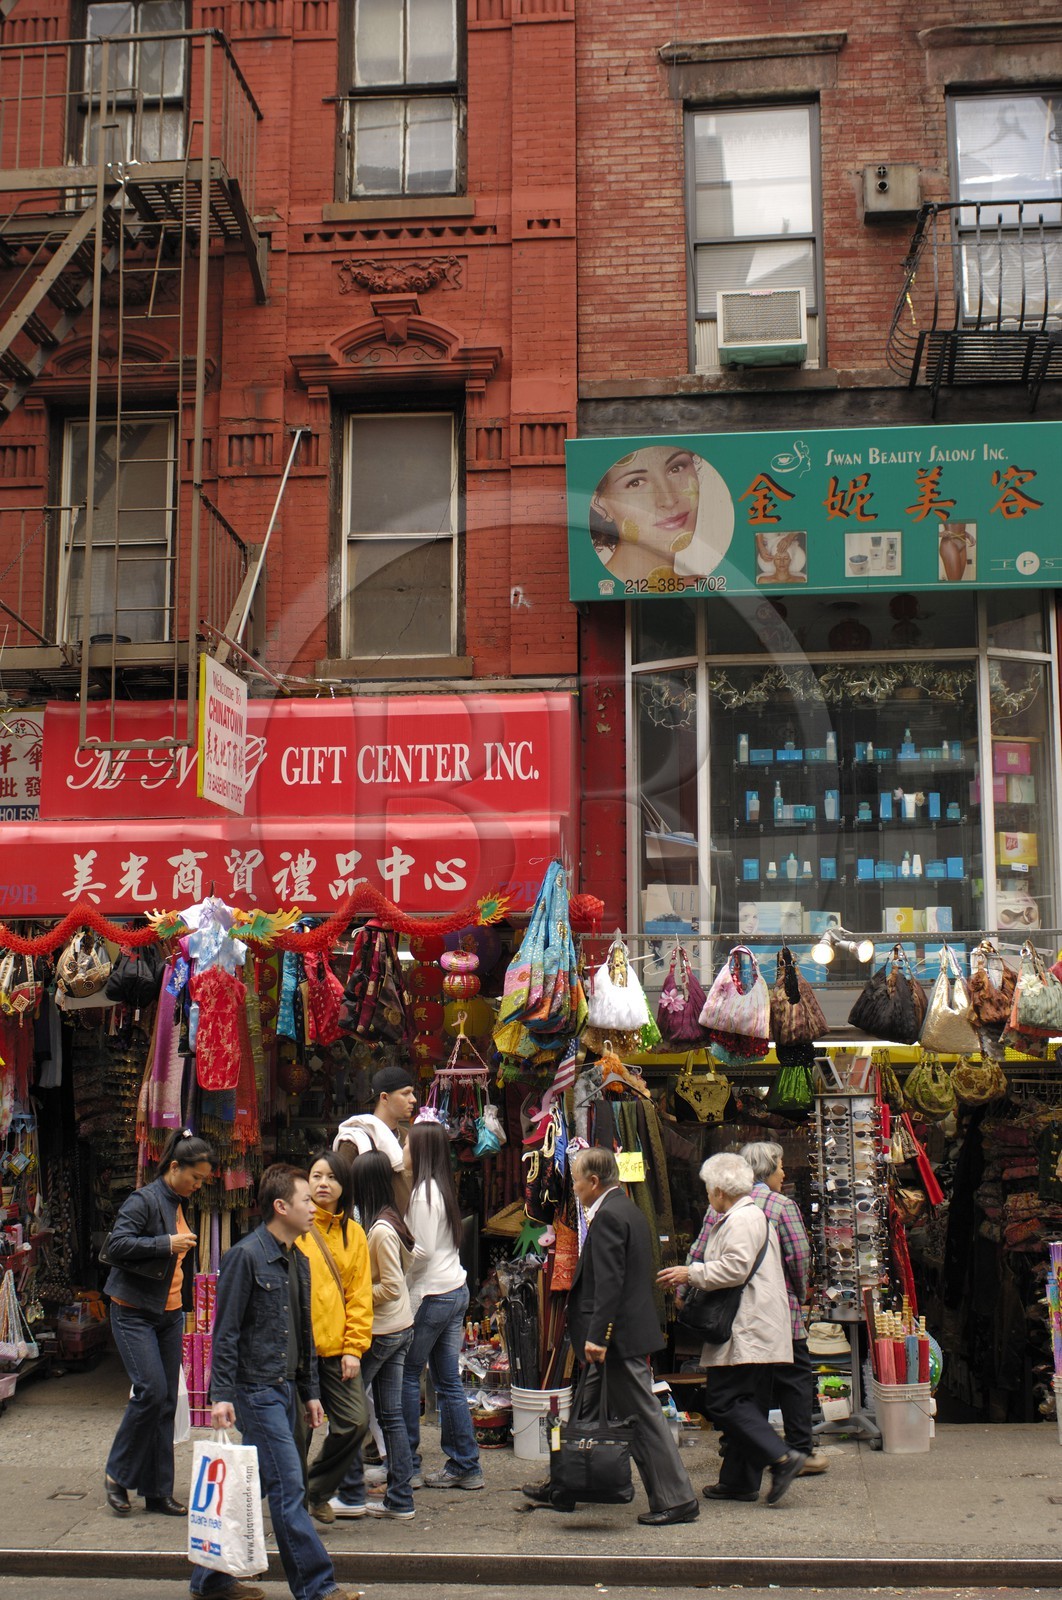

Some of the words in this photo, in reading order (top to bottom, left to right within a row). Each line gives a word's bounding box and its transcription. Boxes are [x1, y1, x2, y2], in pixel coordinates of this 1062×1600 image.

[824, 449, 862, 466] SWAN
[868, 447, 922, 465] BEAUTY
[928, 445, 977, 463] SALONS
[983, 444, 1009, 461] INC.
[738, 464, 1045, 525] 金妮美容
[624, 576, 727, 594] 212-385-1702
[212, 670, 234, 702] Welcome
[235, 686, 242, 706] To
[208, 694, 243, 738] CHINATOWN
[280, 745, 347, 786] GIFT
[357, 743, 473, 784] CENTER
[483, 740, 539, 781] INC.
[0, 884, 37, 905] 79B
